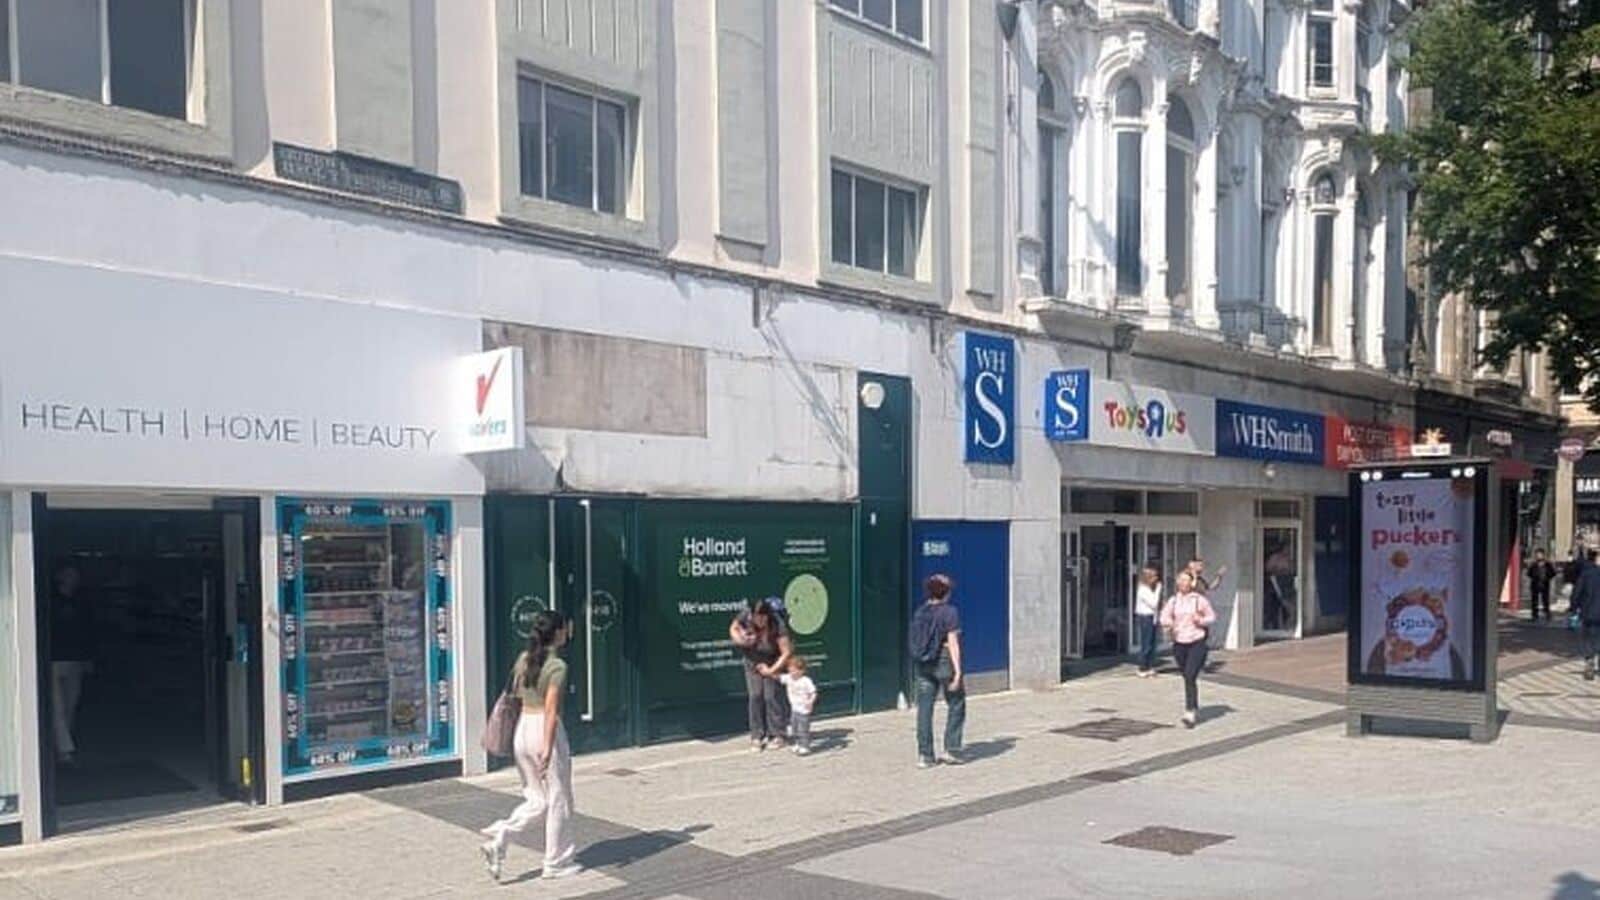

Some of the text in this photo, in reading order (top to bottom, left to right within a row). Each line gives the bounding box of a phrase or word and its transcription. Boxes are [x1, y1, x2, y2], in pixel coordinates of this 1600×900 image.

[973, 346, 1006, 373] WH
[21, 402, 438, 450] HEALTH HOME BEAUTY
[974, 371, 1007, 449] S
[1055, 387, 1079, 430] S
[1231, 412, 1314, 455] WHSmith
[683, 537, 746, 556] Holland
